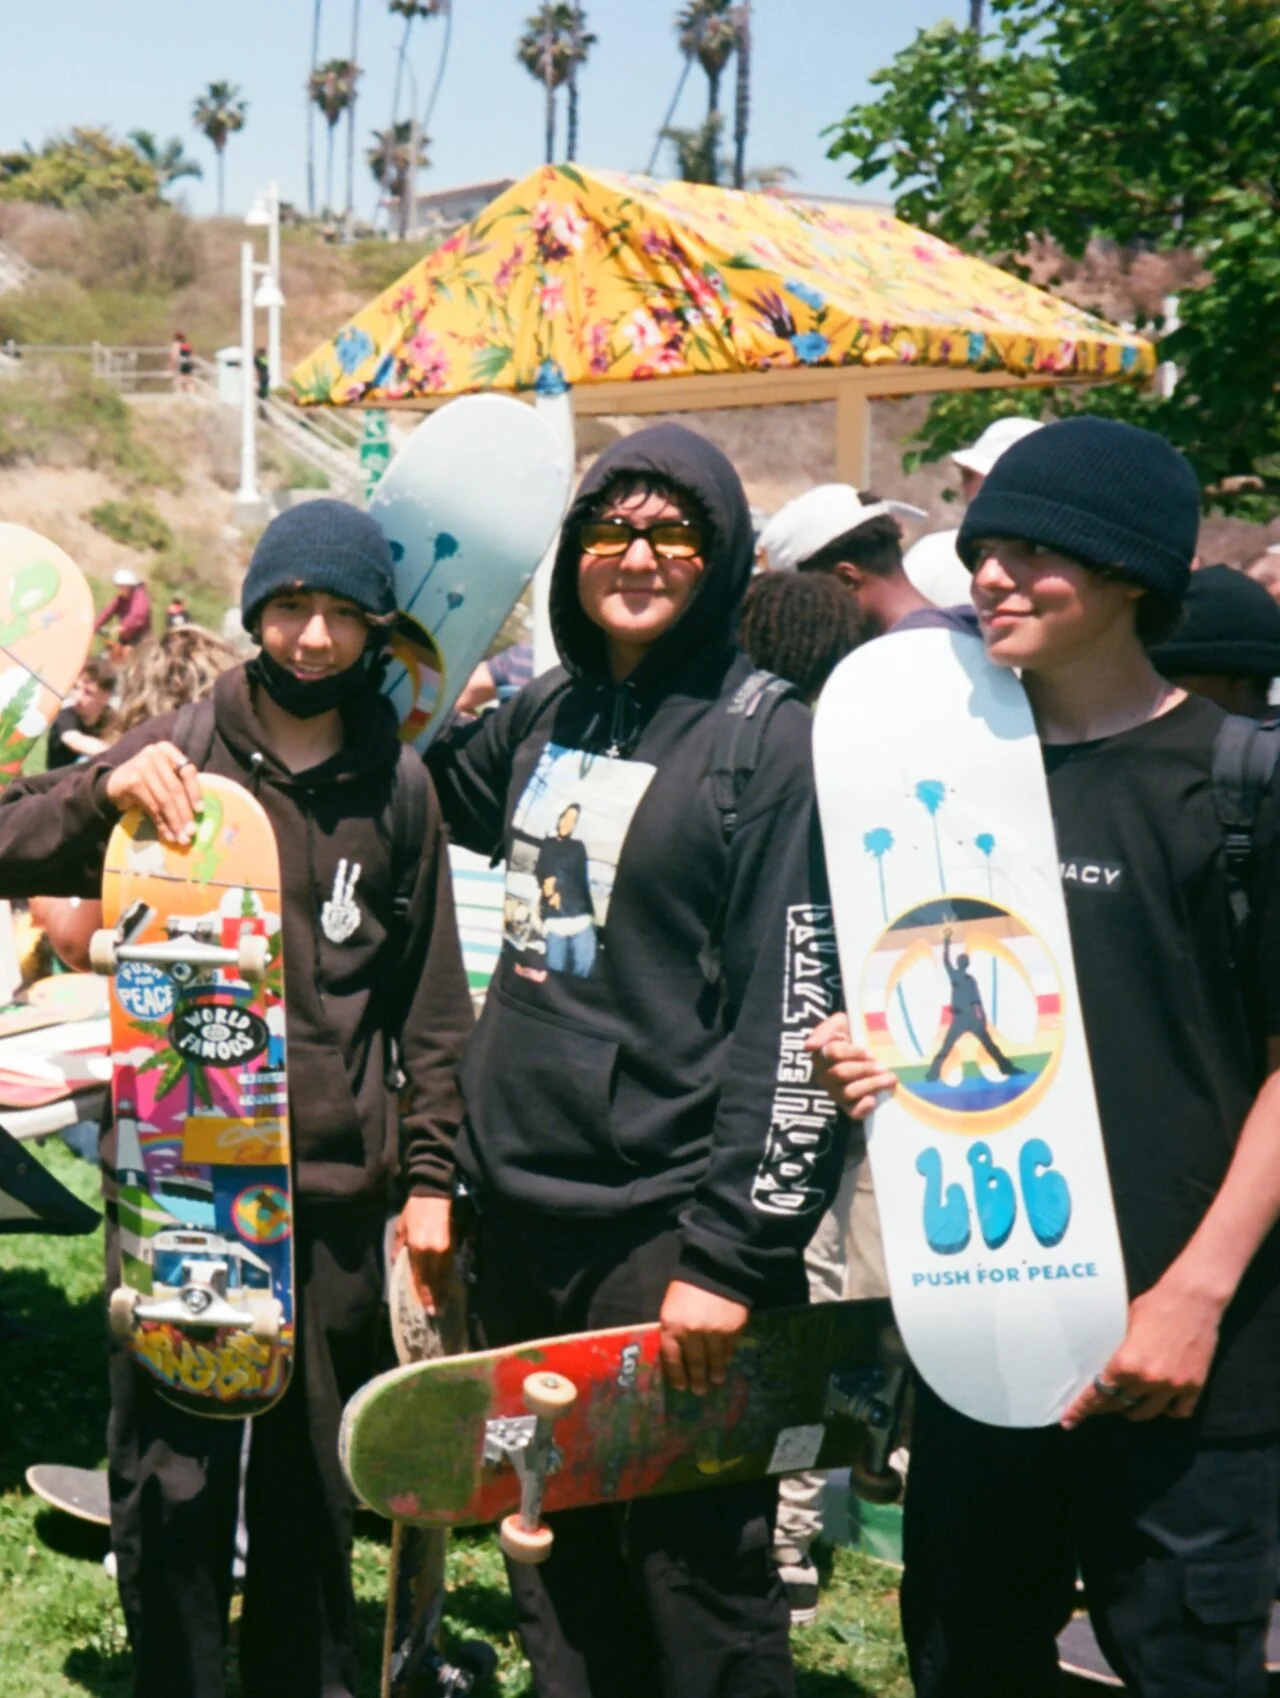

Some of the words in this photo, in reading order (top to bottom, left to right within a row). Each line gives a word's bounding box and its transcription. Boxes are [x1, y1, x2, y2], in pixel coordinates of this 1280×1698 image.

[1059, 863, 1121, 885] ACY
[119, 985, 174, 1015] PEACE
[184, 1007, 251, 1030] WORLD
[179, 1031, 255, 1060] FAMOUS
[915, 1138, 1073, 1256] LBC
[911, 1270, 971, 1288] PUSH
[977, 1266, 1020, 1285] FOR
[1027, 1262, 1098, 1281] PEACE
